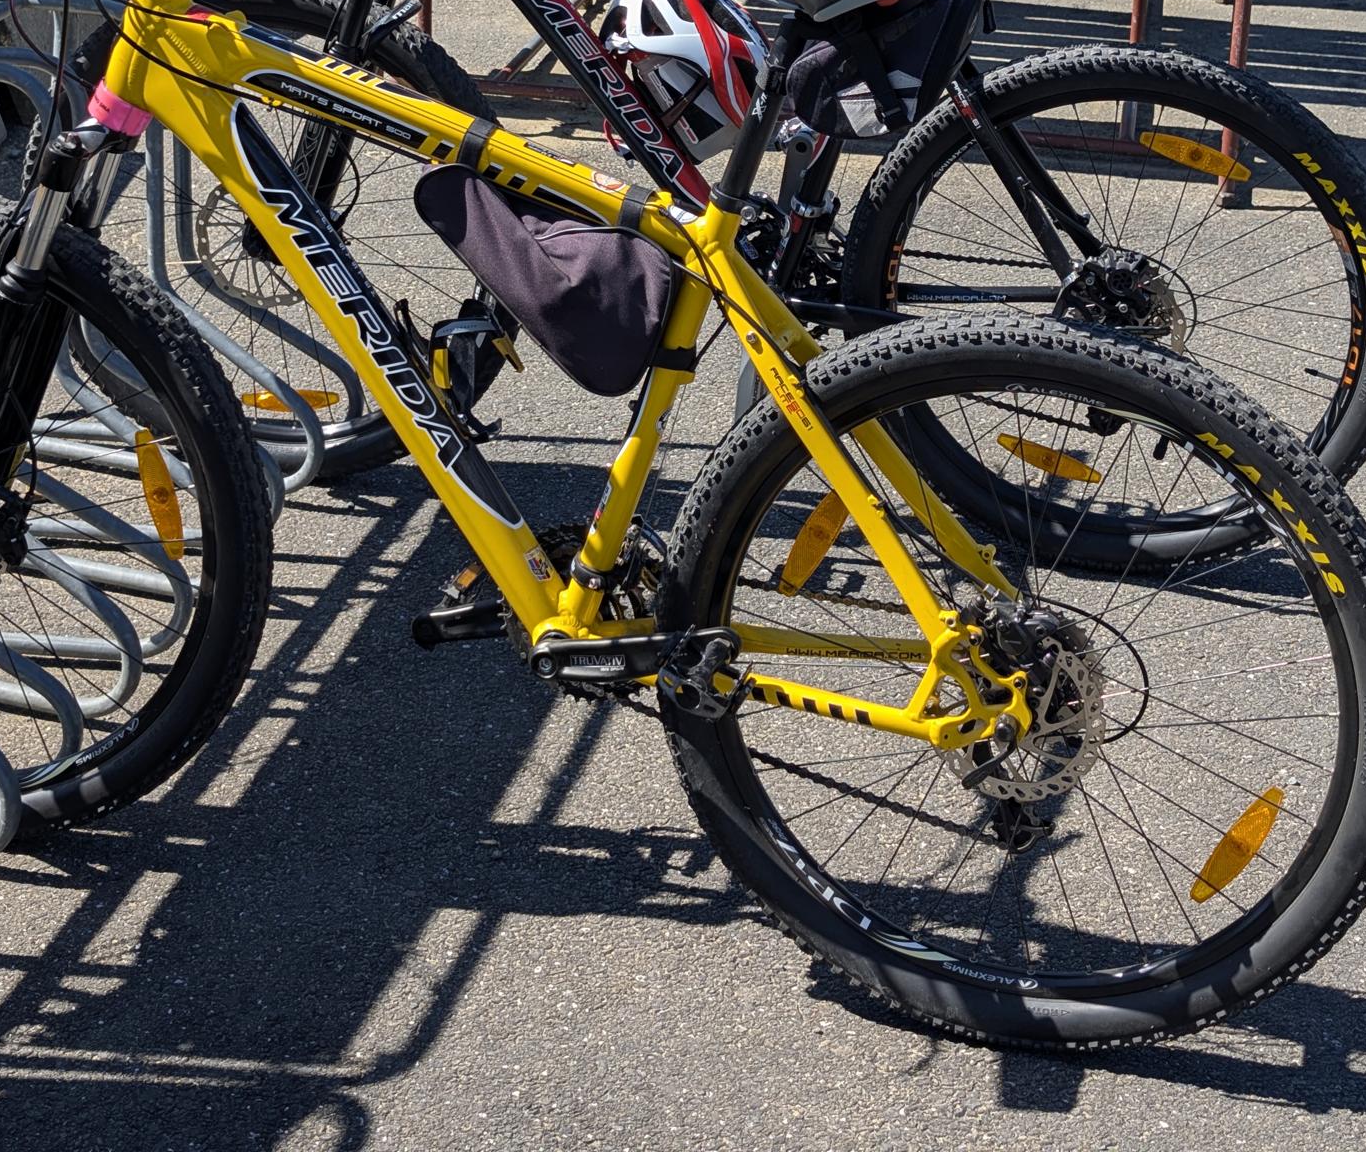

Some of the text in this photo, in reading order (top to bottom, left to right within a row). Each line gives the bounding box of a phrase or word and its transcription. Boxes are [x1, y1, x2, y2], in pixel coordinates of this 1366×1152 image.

[280, 81, 412, 140] MATTS SPORT 500
[259, 188, 464, 471] MERIDA
[1030, 386, 1107, 408] ALEXRIMS
[1195, 431, 1347, 595] MAXXIS
[573, 655, 623, 667] TRUVATIV
[941, 961, 1016, 985] ALEXRIMS
